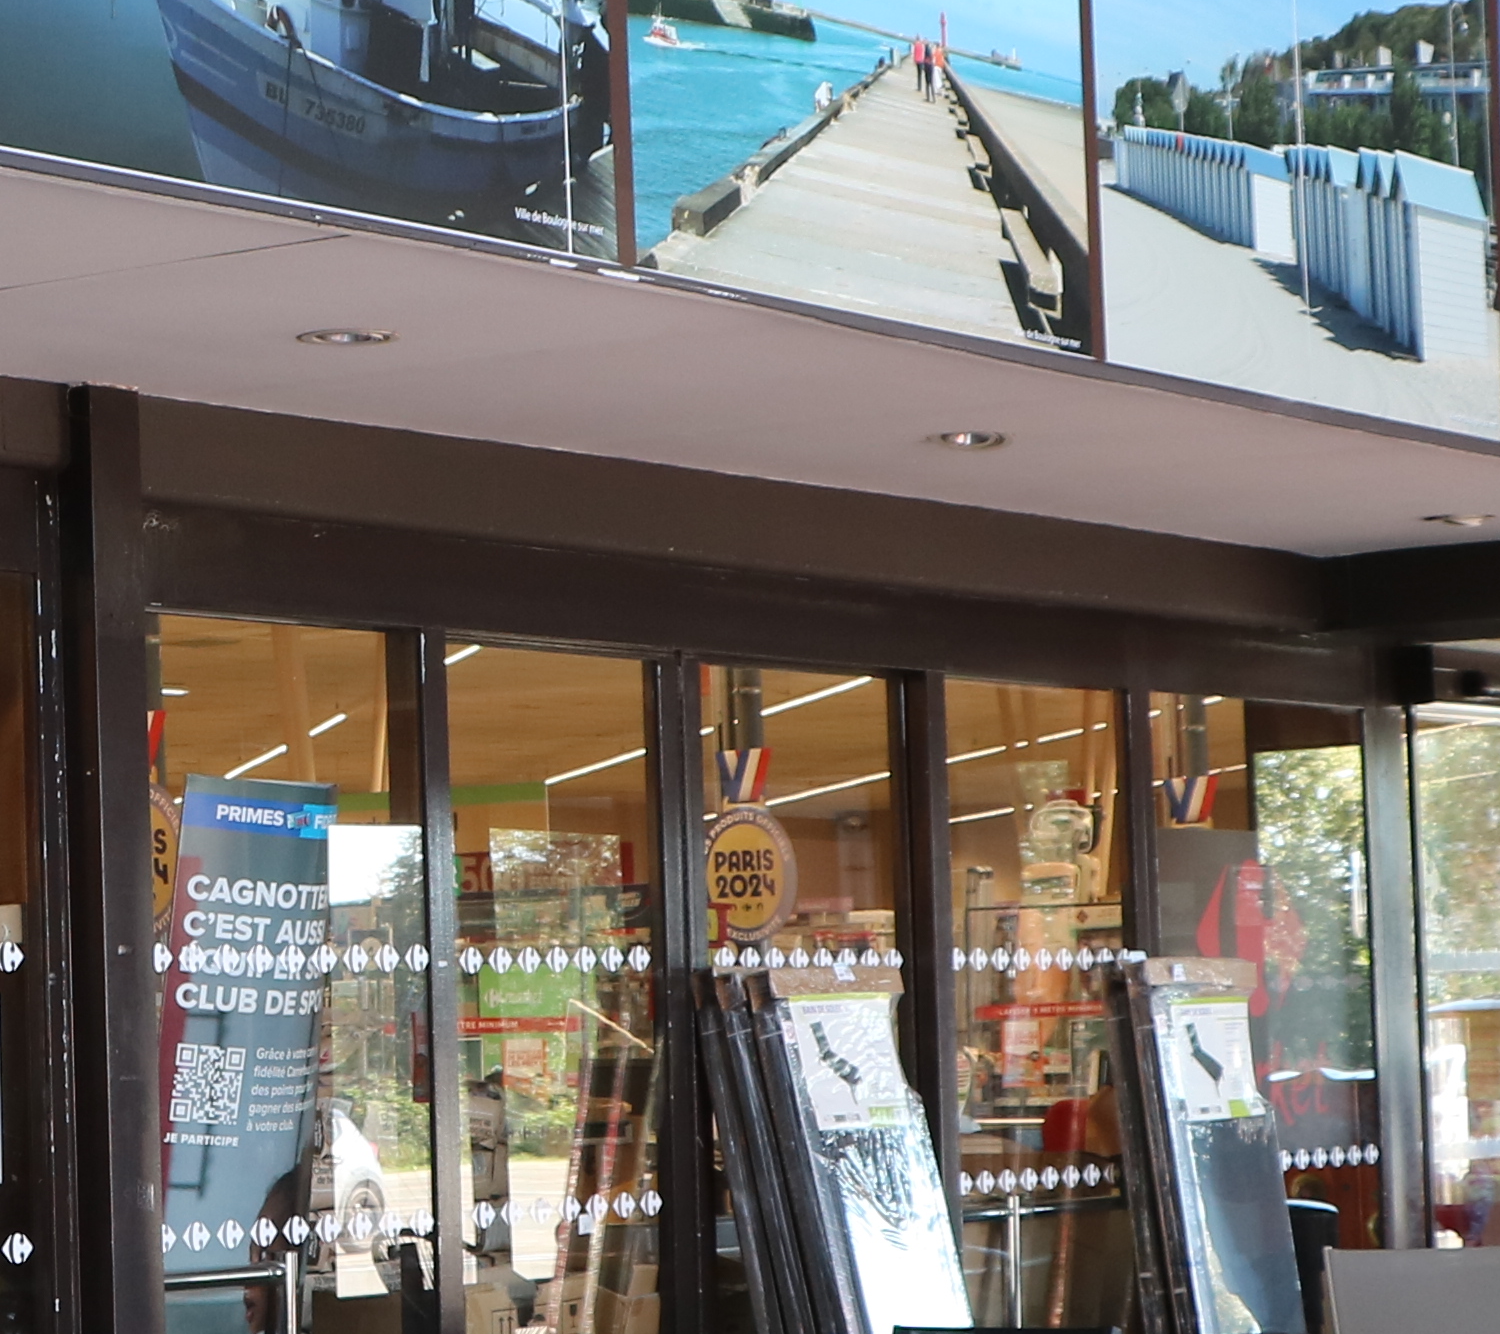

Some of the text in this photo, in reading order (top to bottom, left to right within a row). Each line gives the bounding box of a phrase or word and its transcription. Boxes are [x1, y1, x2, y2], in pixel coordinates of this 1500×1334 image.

[215, 804, 284, 827] PRIMES
[714, 848, 774, 873] PARIS
[187, 874, 328, 910] CAGNOTTE
[715, 873, 776, 899] 2024
[183, 911, 271, 942] C'EST
[175, 982, 322, 1016] CLUB DE SPO
[251, 1083, 269, 1096] des
[248, 1102, 281, 1117] gagner
[254, 1120, 278, 1133] votre
[163, 1132, 240, 1147] JE PARTICIPE
